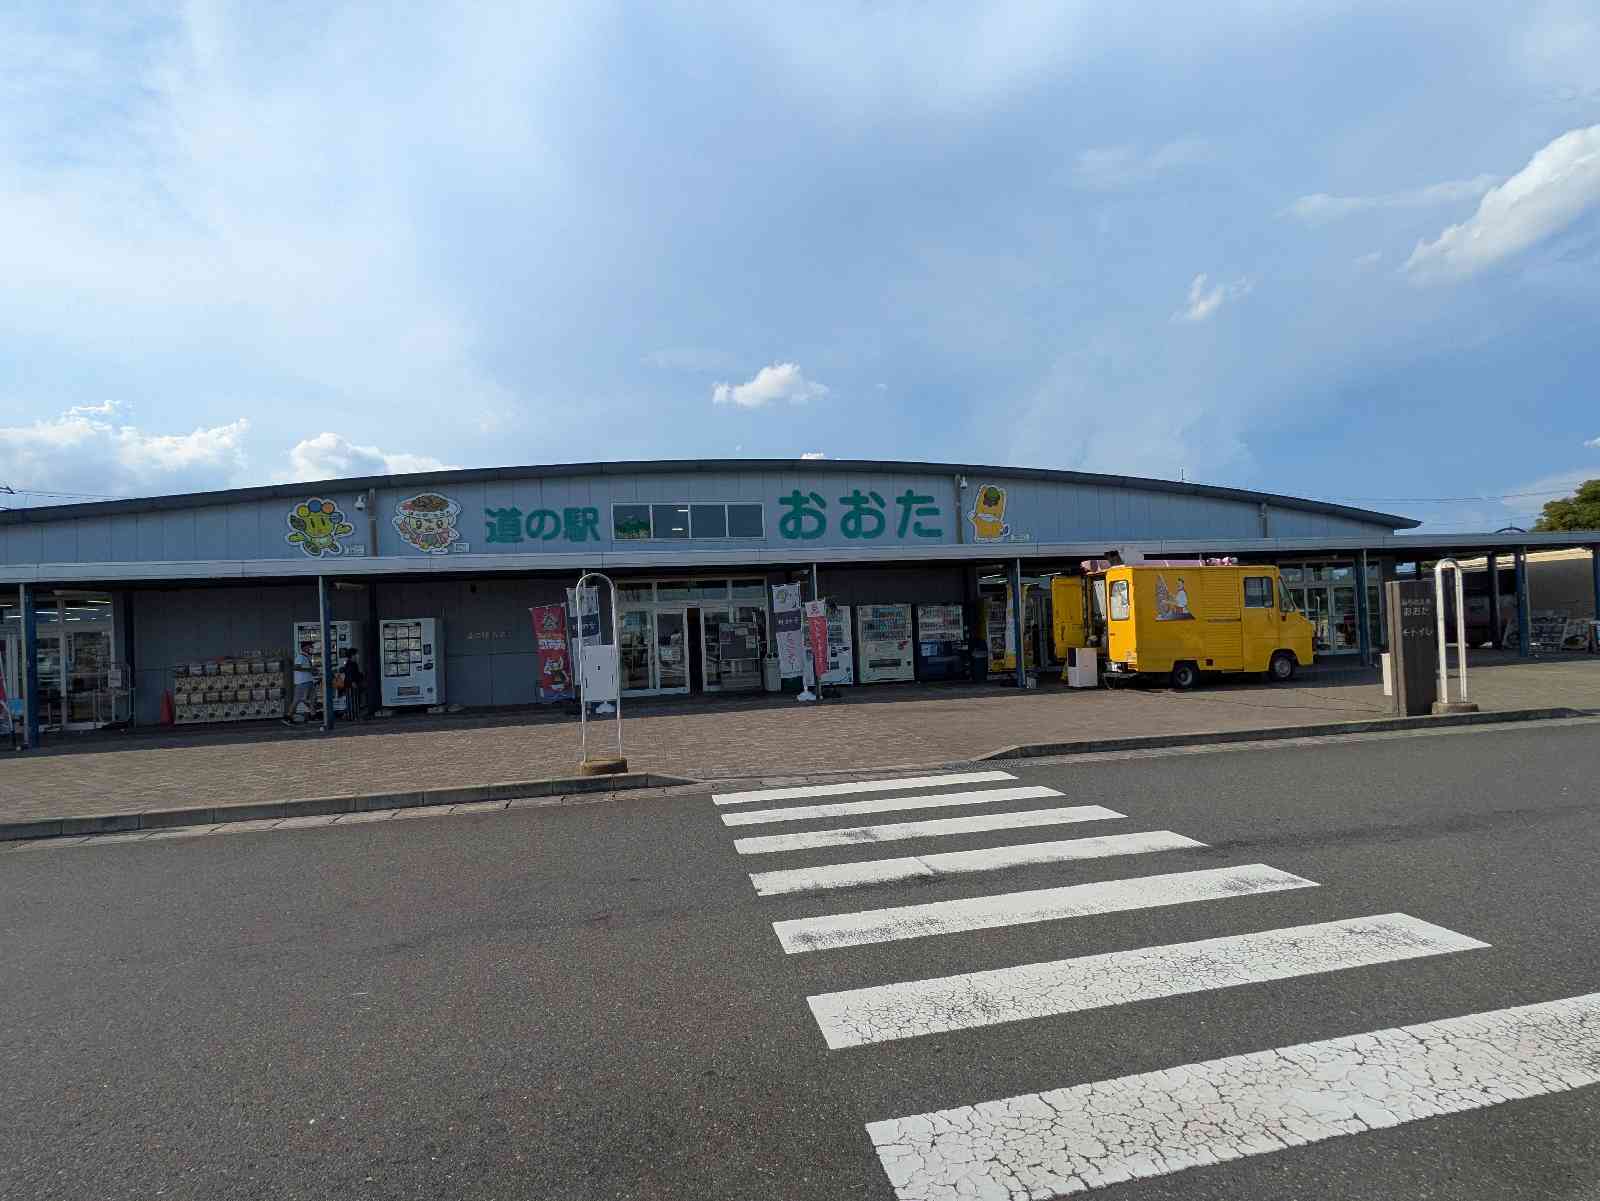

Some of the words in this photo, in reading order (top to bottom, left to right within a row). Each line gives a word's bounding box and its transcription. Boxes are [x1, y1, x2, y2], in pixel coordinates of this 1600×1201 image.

[485, 506, 600, 545] 道の駅
[778, 489, 945, 541] おおた
